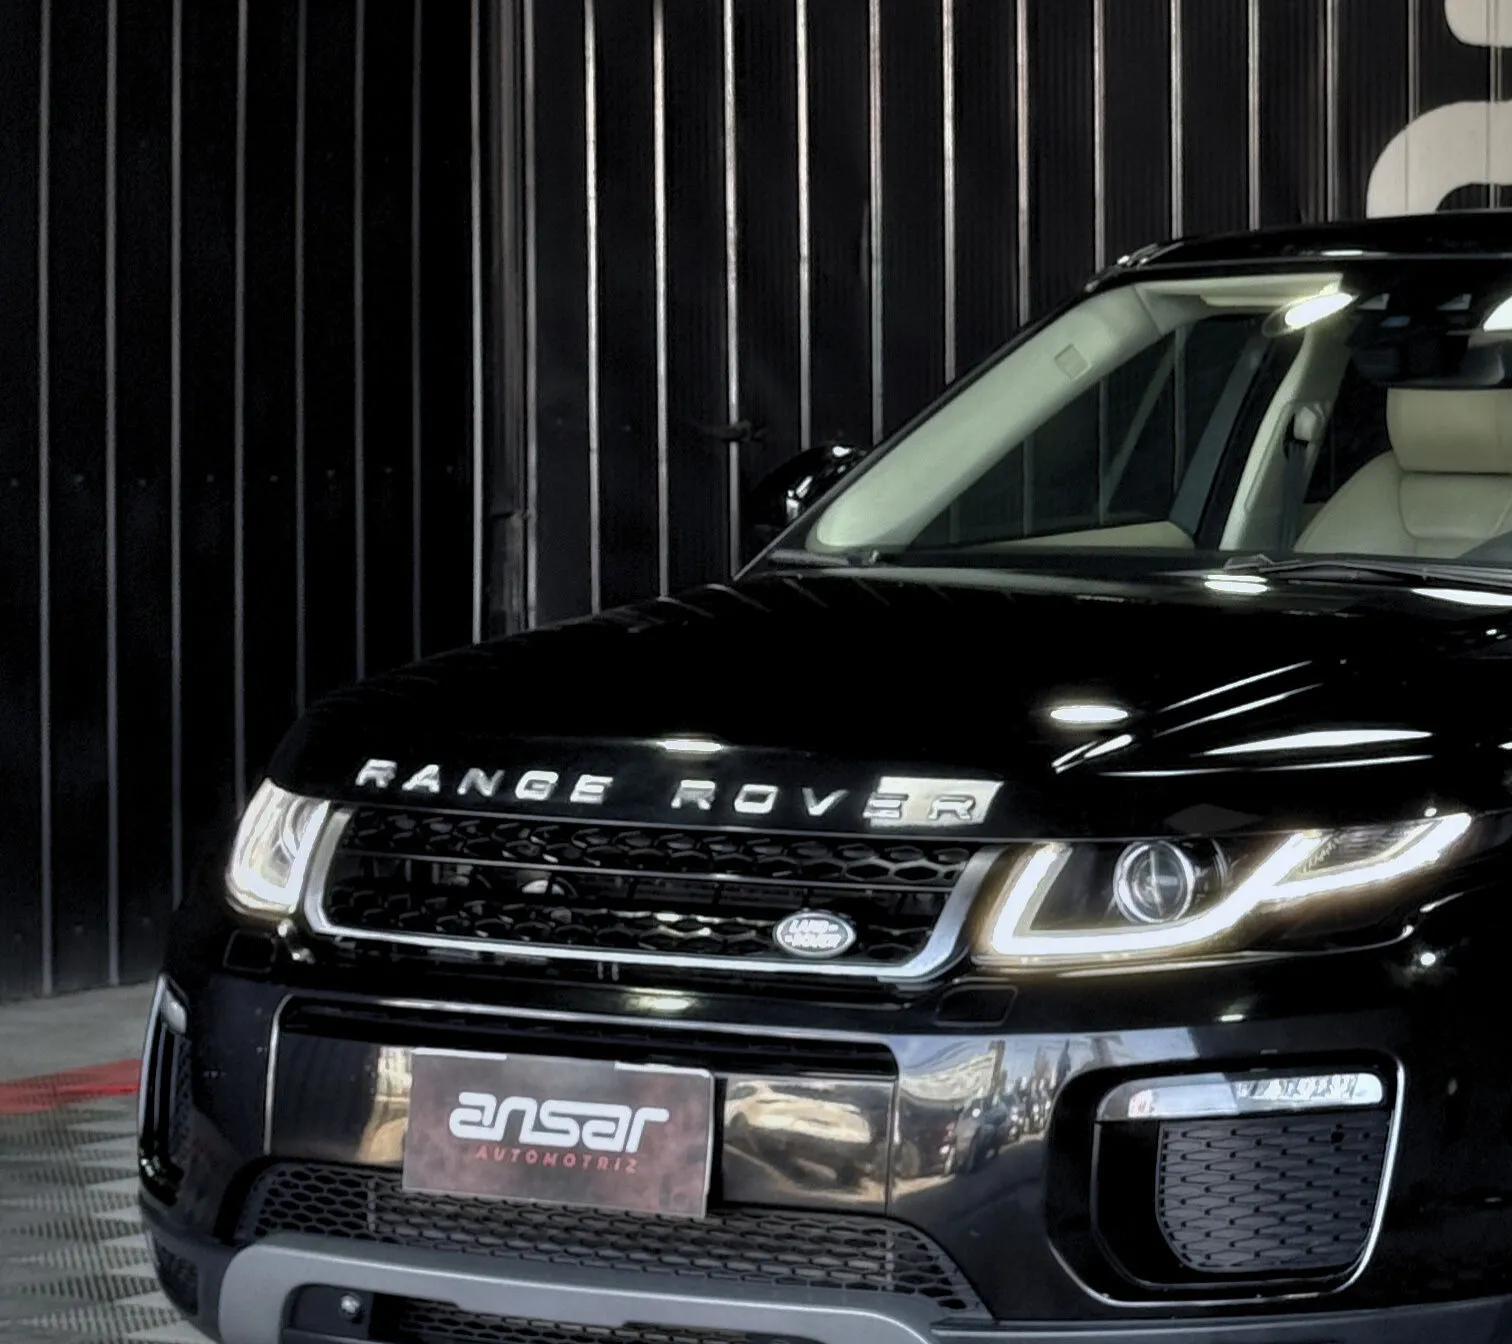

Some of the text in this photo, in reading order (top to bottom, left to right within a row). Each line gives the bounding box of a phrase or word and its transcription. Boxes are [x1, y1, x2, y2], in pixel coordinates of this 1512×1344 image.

[355, 759, 976, 820] RANGE ROVER
[449, 1091, 670, 1154] ansar
[475, 1145, 638, 1174] AUTOMOTRIZ
